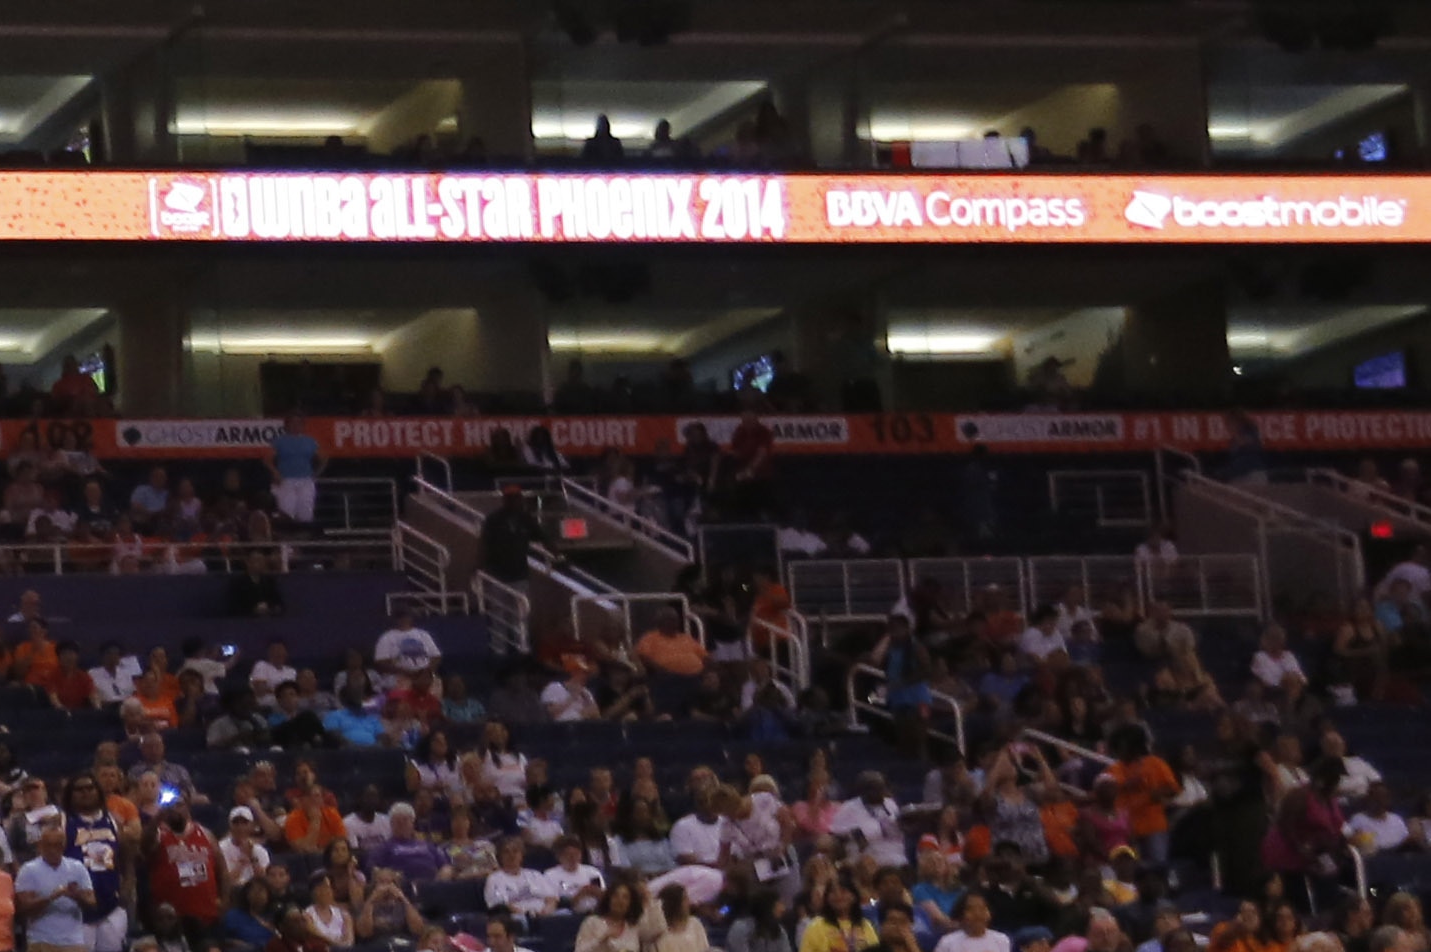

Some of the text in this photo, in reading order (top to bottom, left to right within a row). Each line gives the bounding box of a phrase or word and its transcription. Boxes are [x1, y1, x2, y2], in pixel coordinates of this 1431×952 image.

[700, 176, 786, 237] 2014
[825, 191, 1084, 232] BBVA Compass
[333, 420, 454, 448] PROTECT
